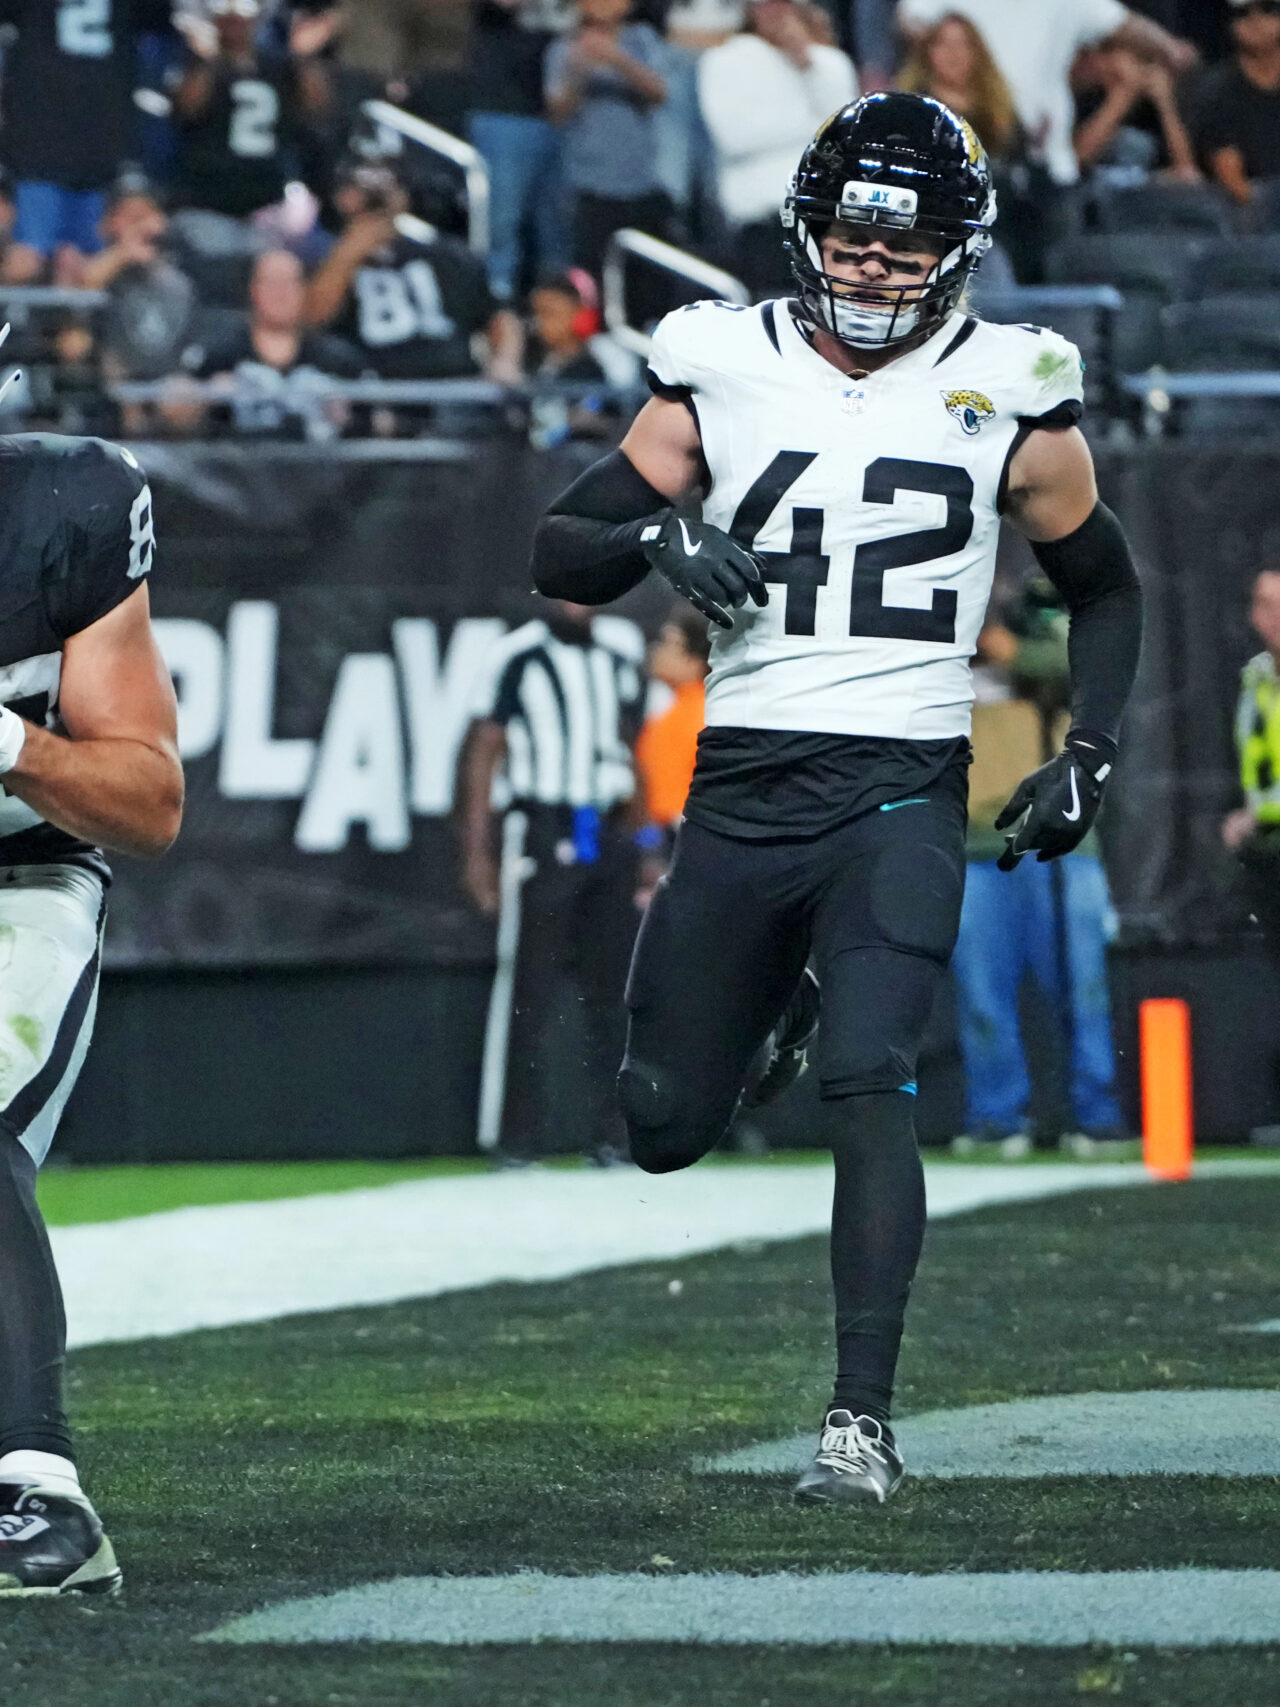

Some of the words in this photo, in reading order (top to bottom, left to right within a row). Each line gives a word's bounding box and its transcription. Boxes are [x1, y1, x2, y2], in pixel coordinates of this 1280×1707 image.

[228, 80, 279, 157] 2
[868, 190, 889, 204] JAX
[355, 259, 455, 347] 81
[726, 449, 974, 644] 42
